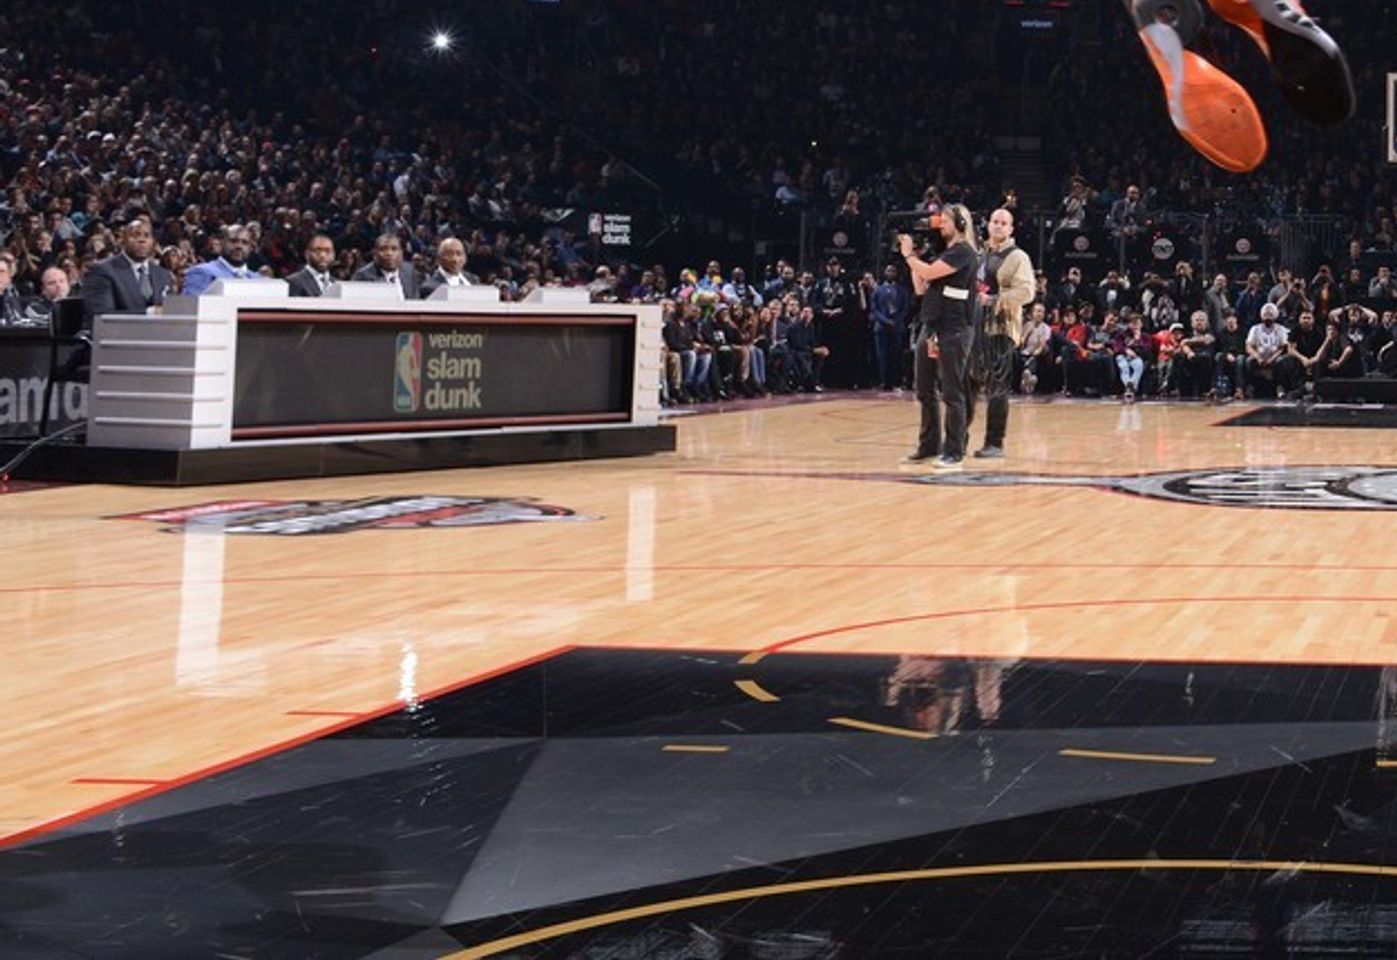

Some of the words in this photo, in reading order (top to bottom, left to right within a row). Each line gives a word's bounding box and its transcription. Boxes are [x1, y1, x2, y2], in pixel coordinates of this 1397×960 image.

[428, 330, 483, 349] verizon
[426, 351, 482, 380] slam
[425, 381, 482, 410] dunk
